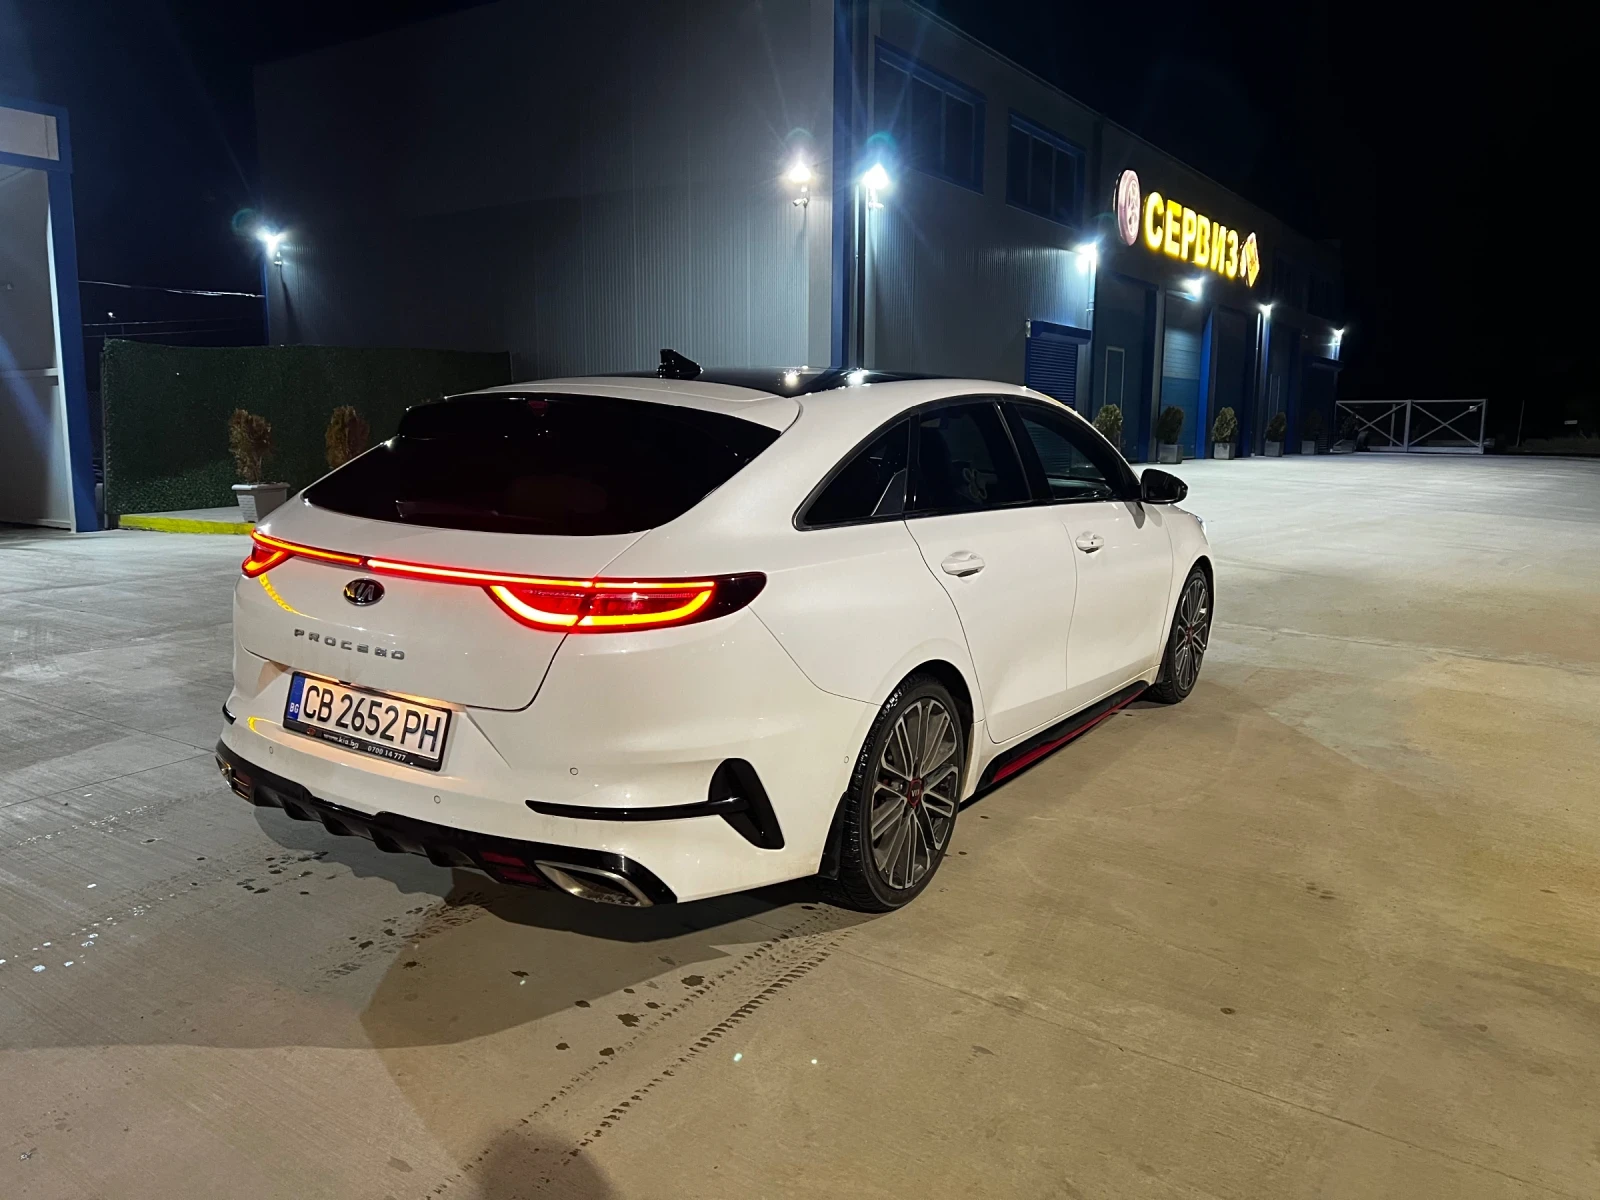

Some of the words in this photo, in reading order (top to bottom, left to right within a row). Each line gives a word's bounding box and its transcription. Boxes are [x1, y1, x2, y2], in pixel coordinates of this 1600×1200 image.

[1144, 191, 1239, 279] СЕРВИЗ
[346, 582, 375, 600] KIA
[294, 628, 405, 660] PROCEED
[289, 702, 300, 714] BG
[335, 693, 399, 742] 2652
[323, 733, 359, 750] www.kia.bg
